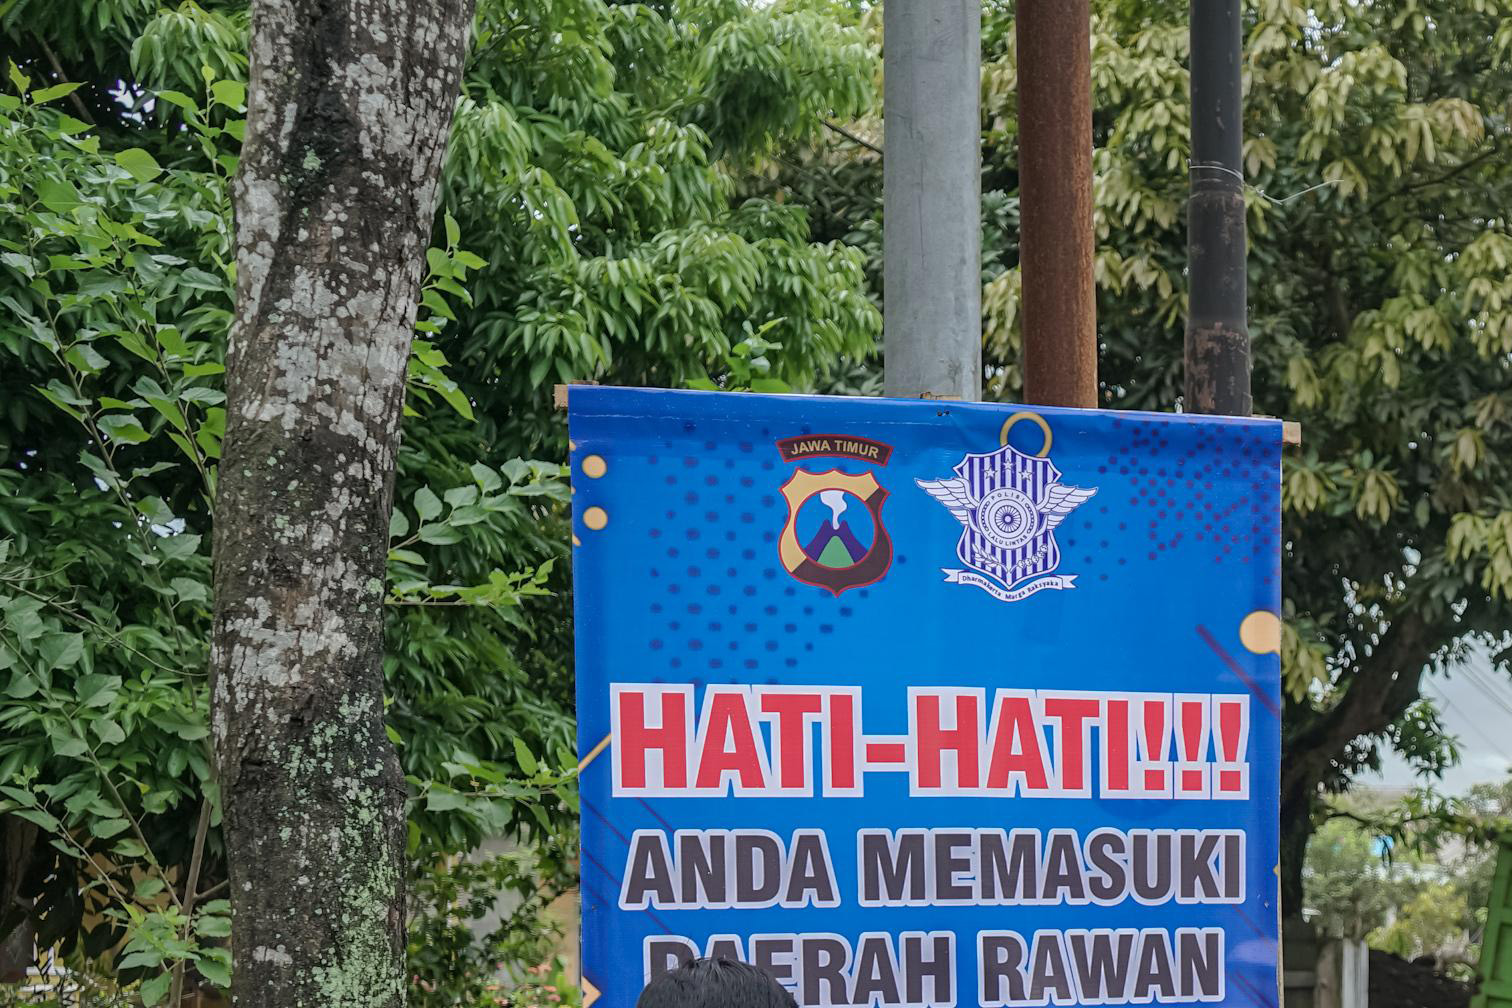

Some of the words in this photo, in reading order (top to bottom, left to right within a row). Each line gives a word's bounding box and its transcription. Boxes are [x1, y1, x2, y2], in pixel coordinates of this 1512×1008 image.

[790, 439, 831, 456] JAWA
[833, 439, 880, 459] TIMUR
[990, 490, 1026, 504] POLISI
[988, 531, 1005, 547] LALU
[1004, 533, 1030, 547] LINTAS
[1003, 589, 1027, 601] Marga
[615, 687, 1246, 796] HATI-HATI!!!
[621, 831, 835, 908] ANDA
[859, 829, 1244, 906] MEMASUKI
[981, 930, 1222, 1002] RAWAN
